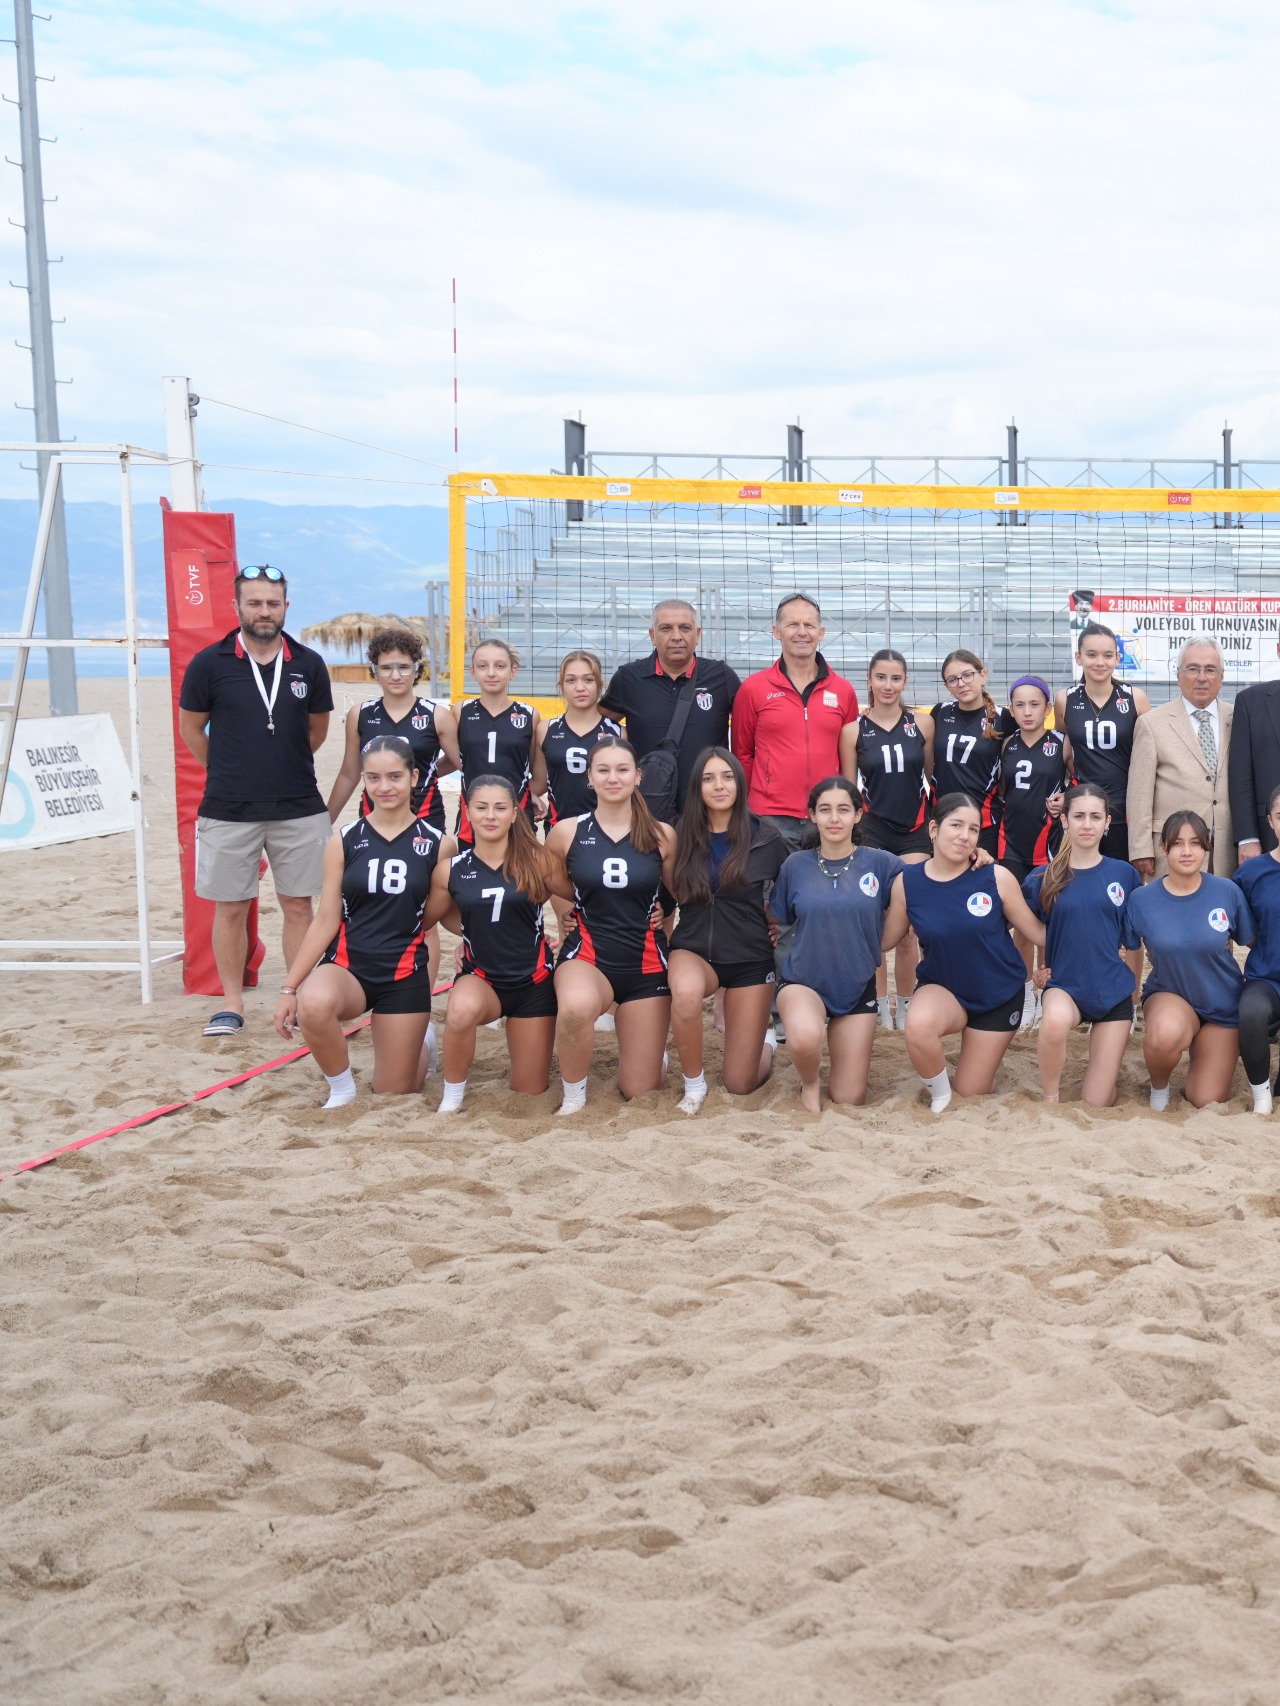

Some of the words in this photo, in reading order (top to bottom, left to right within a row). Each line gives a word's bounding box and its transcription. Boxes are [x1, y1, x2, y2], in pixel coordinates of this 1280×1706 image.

[189, 565, 200, 588] TVF
[1108, 599, 1175, 612] 2.BURHANİYE
[1185, 598, 1212, 612] ÖREN
[1214, 598, 1258, 613] ATATÜRK
[1136, 617, 1195, 631] VOLEYBOL
[487, 731, 497, 763] 1
[946, 733, 977, 764] 17
[1084, 720, 1117, 750] 10
[26, 741, 82, 767] BALIKESİR
[566, 747, 587, 774] 6
[881, 744, 904, 773] 11
[34, 764, 102, 793] BÜYÜKŞEHİR
[1015, 760, 1033, 790] 2
[45, 789, 105, 818] BELEDİYESİ
[368, 858, 408, 894] 18
[602, 857, 628, 889] 8
[482, 886, 505, 923] 7
